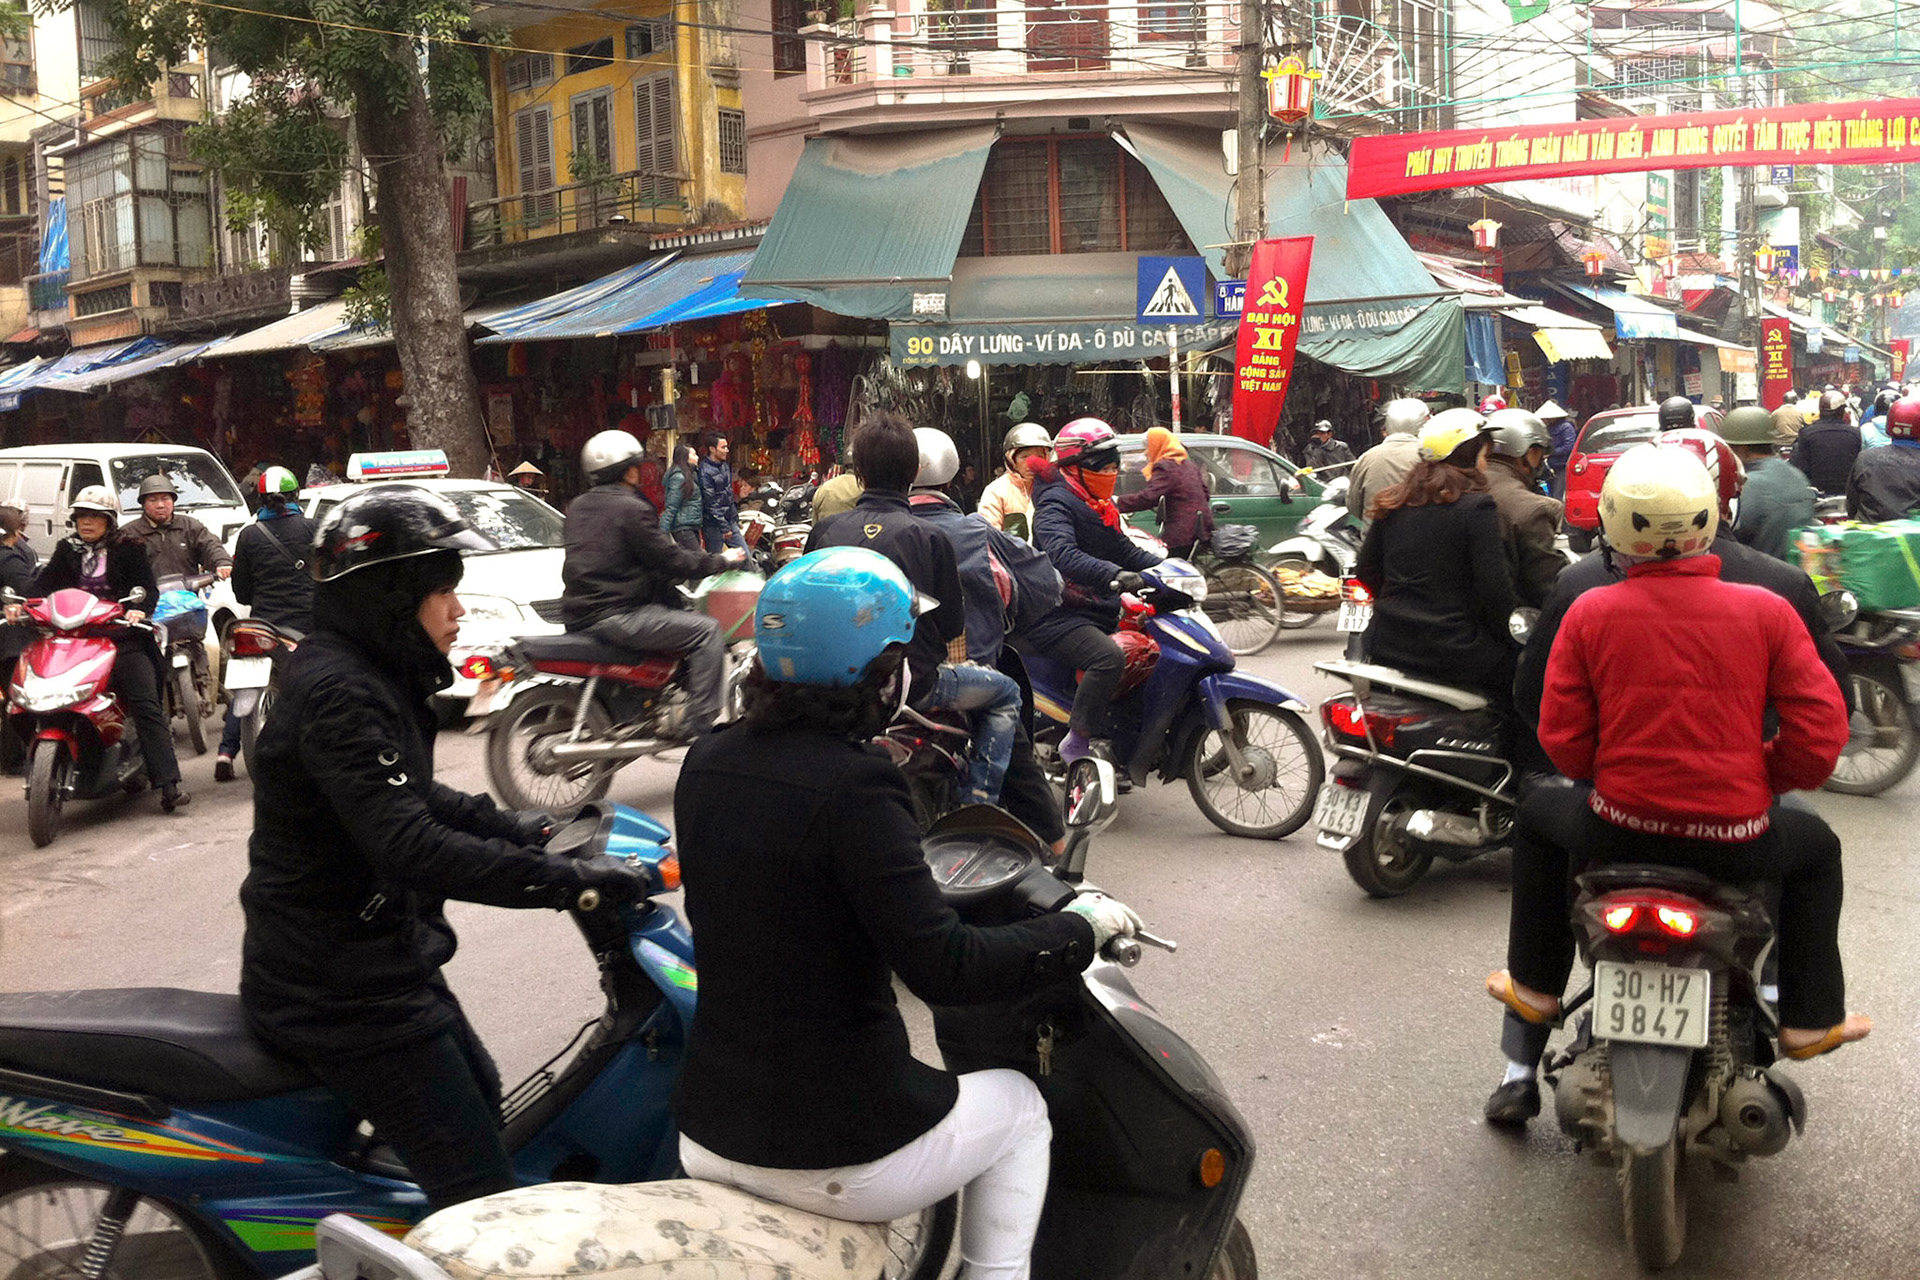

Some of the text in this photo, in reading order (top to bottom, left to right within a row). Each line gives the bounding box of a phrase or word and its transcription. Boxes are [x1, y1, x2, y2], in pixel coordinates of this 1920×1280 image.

[1405, 146, 1431, 177] PHÁT
[1432, 147, 1454, 175] HUY
[1650, 129, 1675, 157] ANH
[1712, 117, 1748, 155] QUYẾT
[1753, 117, 1778, 151] TÂM
[1781, 119, 1810, 155] THỰC
[1814, 114, 1842, 154] HIỆN
[1246, 312, 1296, 326] ĐẠI HỘI
[1341, 314, 1355, 330] DA
[1379, 310, 1397, 326] CAO
[907, 337, 934, 355] 90
[939, 333, 975, 354] DÂY
[980, 334, 1023, 354] LƯNG
[1035, 329, 1056, 351] VÍ
[1058, 333, 1083, 351] DA
[1094, 328, 1106, 349] Ô
[1113, 326, 1135, 348] DÙ
[1252, 327, 1285, 350] XI
[1252, 352, 1280, 366] ĐẢNG
[1768, 351, 1783, 362] XI
[1240, 365, 1267, 378] CỘNG
[1241, 379, 1261, 392] VIỆT
[1318, 808, 1356, 832] 7643
[1610, 1002, 1690, 1040] 9847
[0, 1096, 148, 1144] Wave
